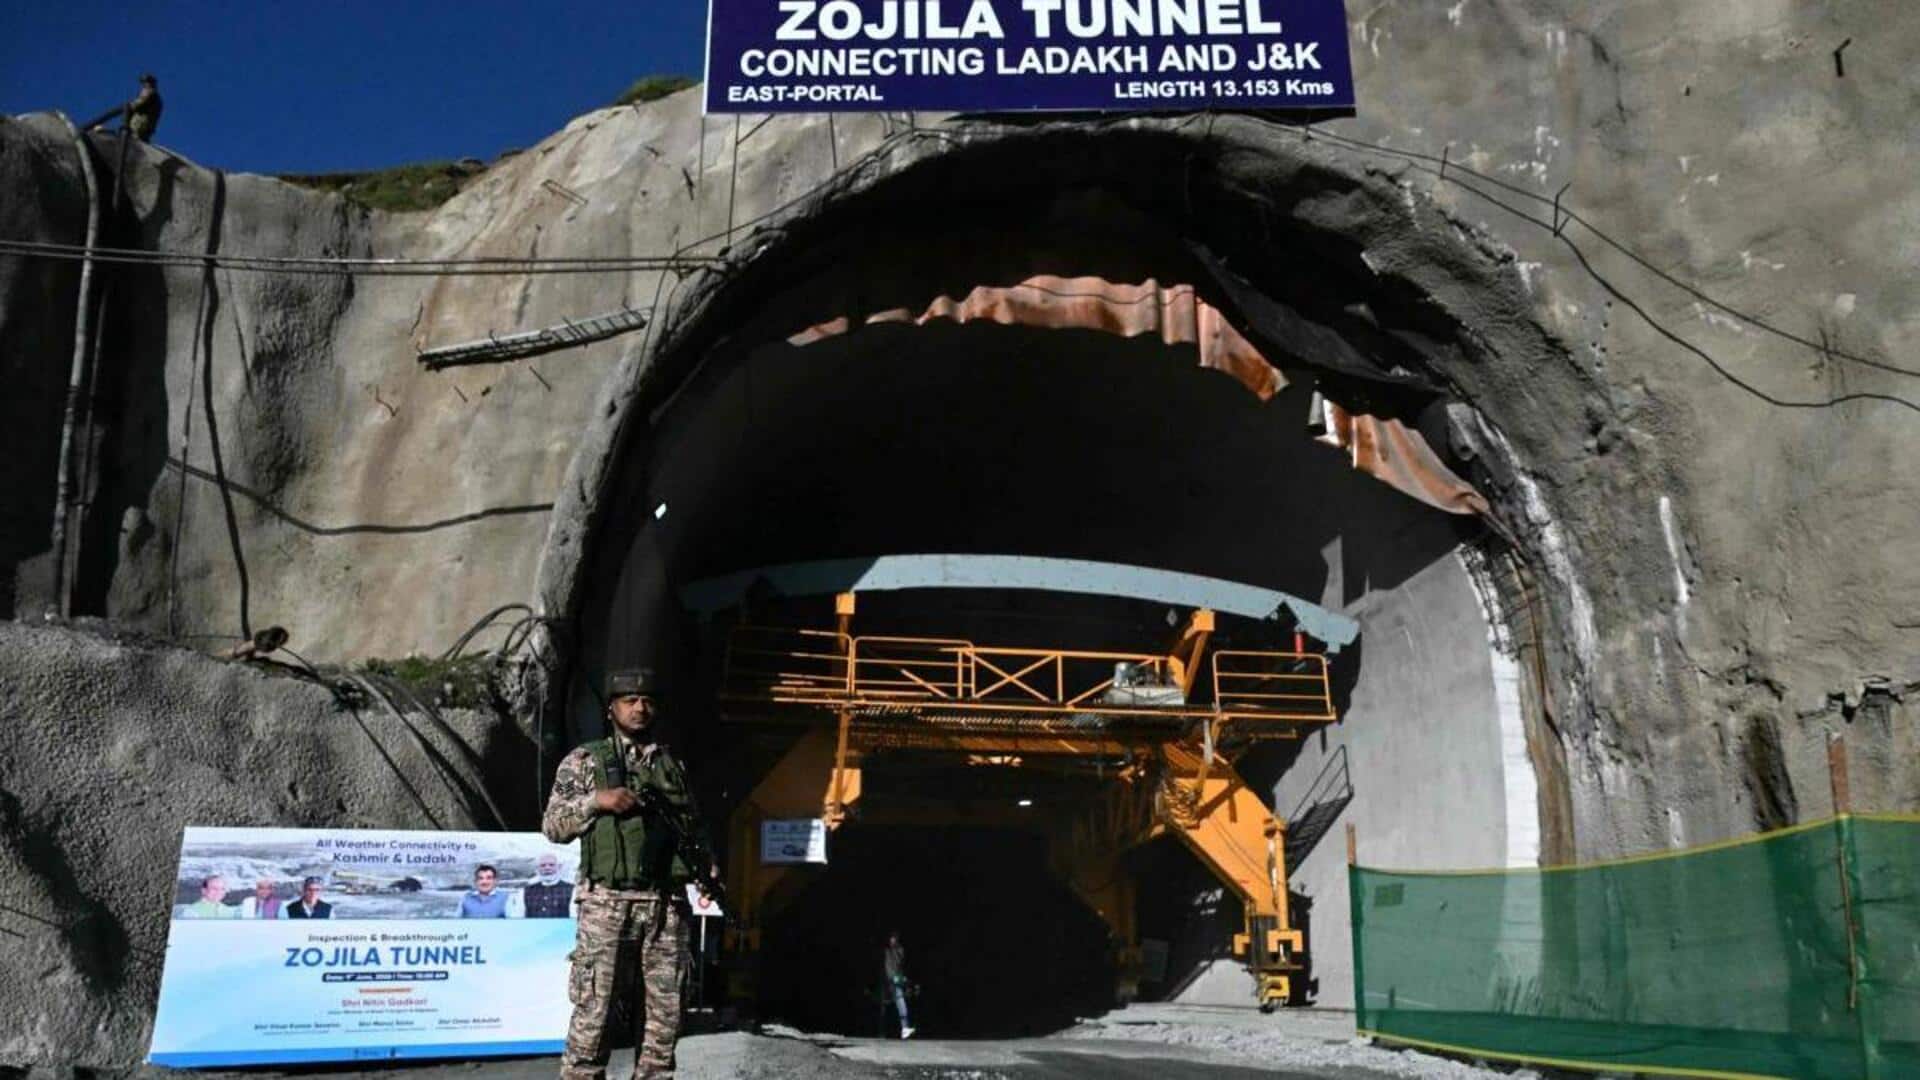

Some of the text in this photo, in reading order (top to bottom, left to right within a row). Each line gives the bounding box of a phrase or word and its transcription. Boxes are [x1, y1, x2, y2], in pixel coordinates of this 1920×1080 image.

[775, 0, 1282, 40] ZOJILA TUNNEL
[740, 42, 1321, 77] CONNECTING LADAKH AND J&K
[728, 85, 883, 102] EAST-PORTAL
[1115, 79, 1334, 98] LENGTH 13.153 Kms
[316, 839, 477, 851] All Weather Connectivity to
[333, 852, 456, 864] Kashmir & Ladakh
[308, 933, 468, 943] Inspection & Breakthrough of
[285, 946, 486, 967] ZOJILA TUNNEL
